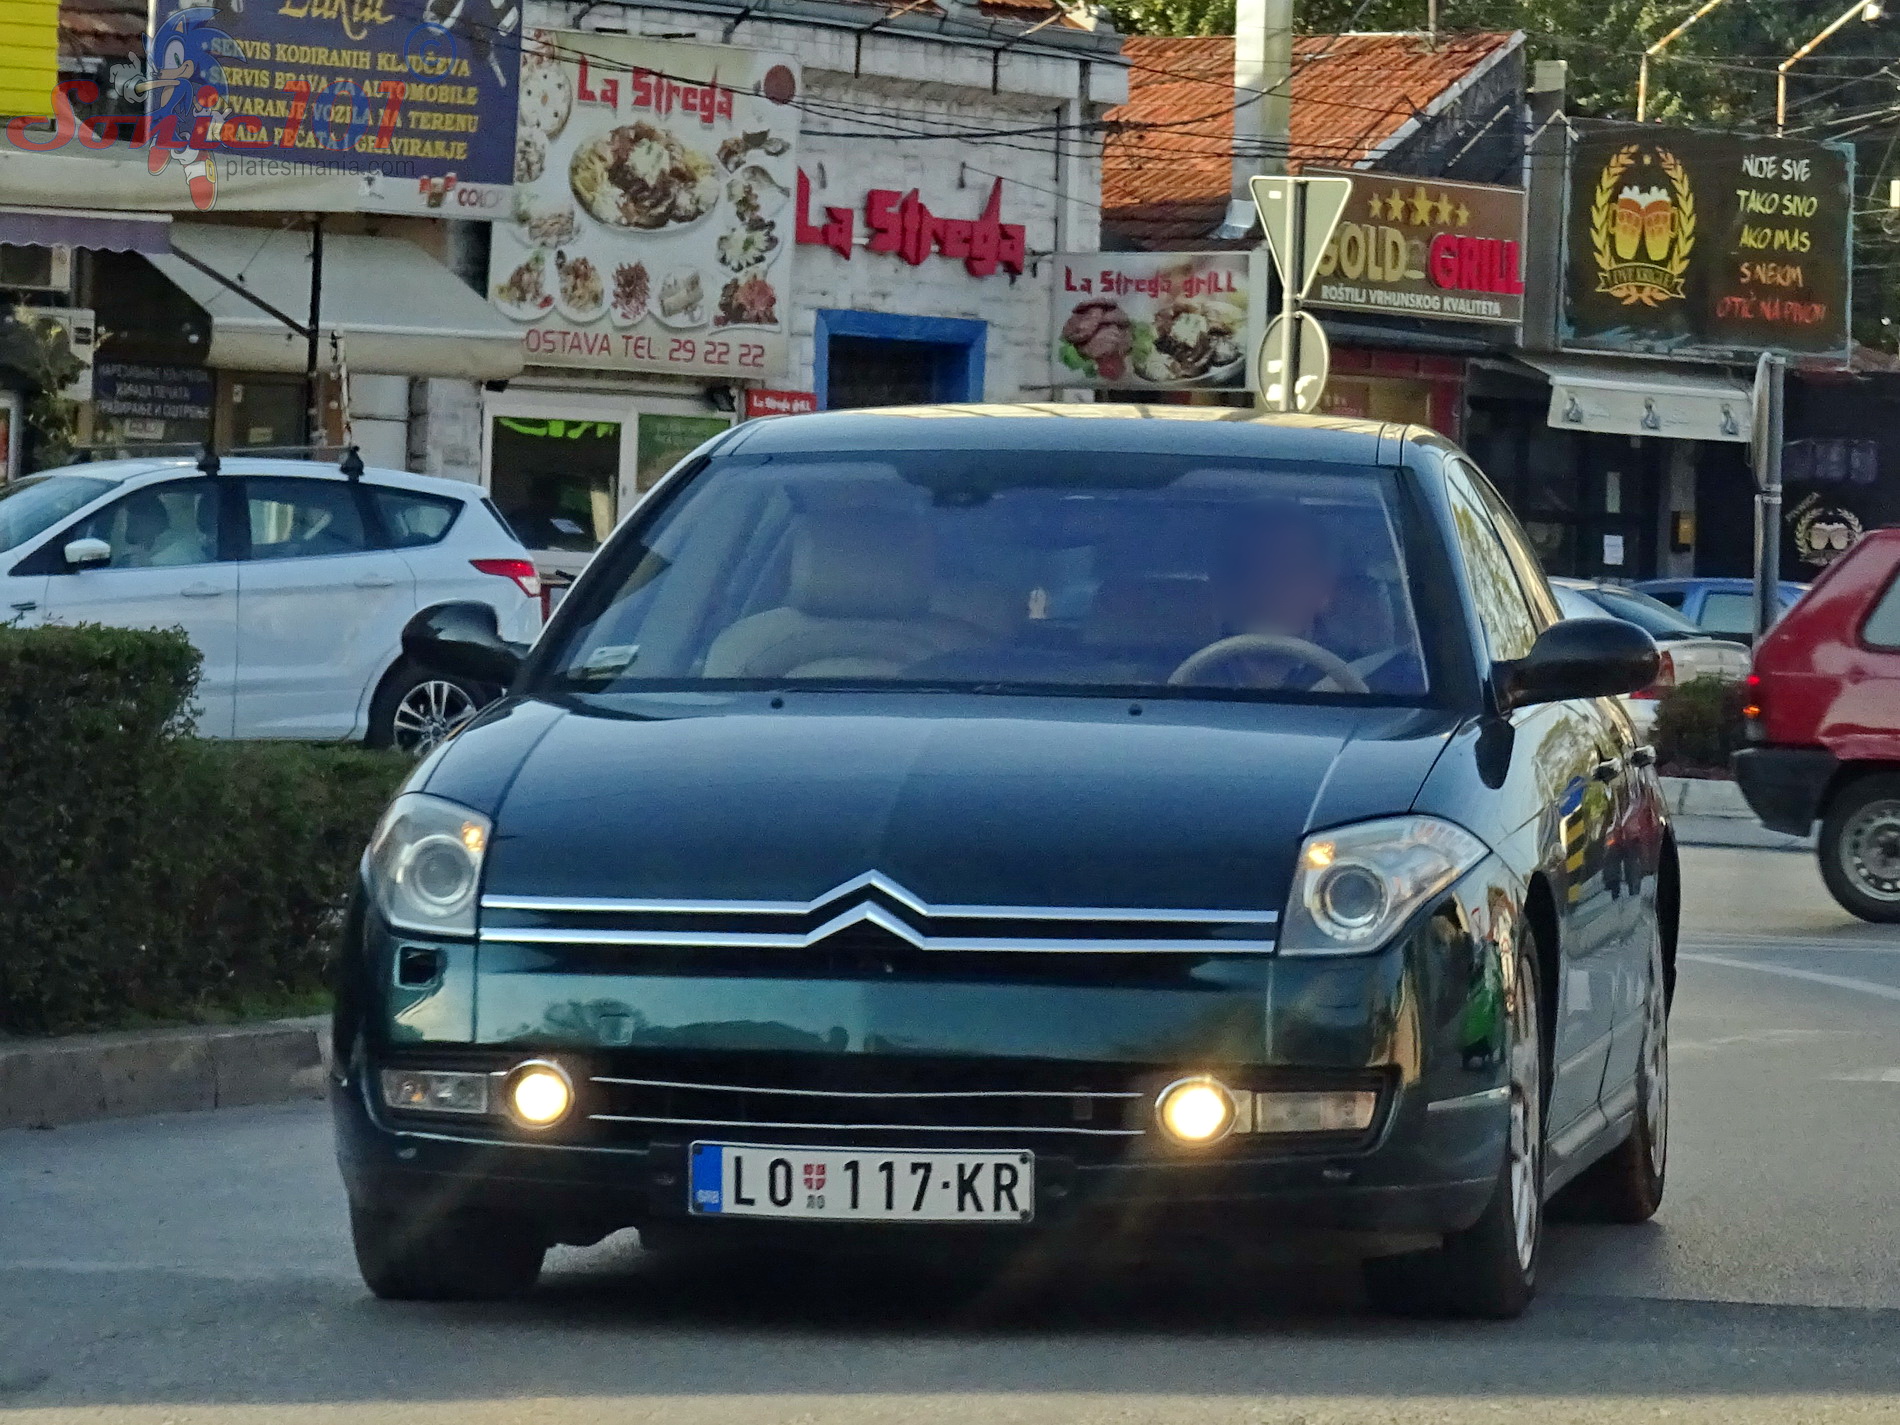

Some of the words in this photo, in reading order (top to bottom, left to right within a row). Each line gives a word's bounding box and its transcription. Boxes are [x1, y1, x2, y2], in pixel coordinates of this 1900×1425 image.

[211, 37, 271, 60] SERVIS
[275, 43, 371, 70] KODIRANIH
[210, 66, 270, 88] SERVIS
[275, 72, 329, 93] BRAVA
[335, 77, 356, 95] ZA
[361, 80, 479, 106] AUTOMOBILE
[577, 53, 618, 109] La
[632, 65, 733, 124] Strega
[313, 103, 373, 126] VOZILA
[407, 111, 479, 133] TERENU
[274, 126, 338, 150] PEČATA
[354, 136, 468, 160] GRAVIRANJE
[1781, 158, 1811, 182] SVE
[1736, 189, 1779, 214] TAKO
[796, 165, 854, 261] La
[865, 175, 1026, 278] Strega
[1428, 232, 1525, 294] GRILL
[1065, 266, 1093, 295] La
[1369, 289, 1441, 311] VRHUNSKOG
[1443, 297, 1501, 316] KVALITETA
[669, 338, 696, 363] 29
[704, 341, 730, 365] 22
[738, 344, 765, 368] 22
[734, 1155, 793, 1208] LO
